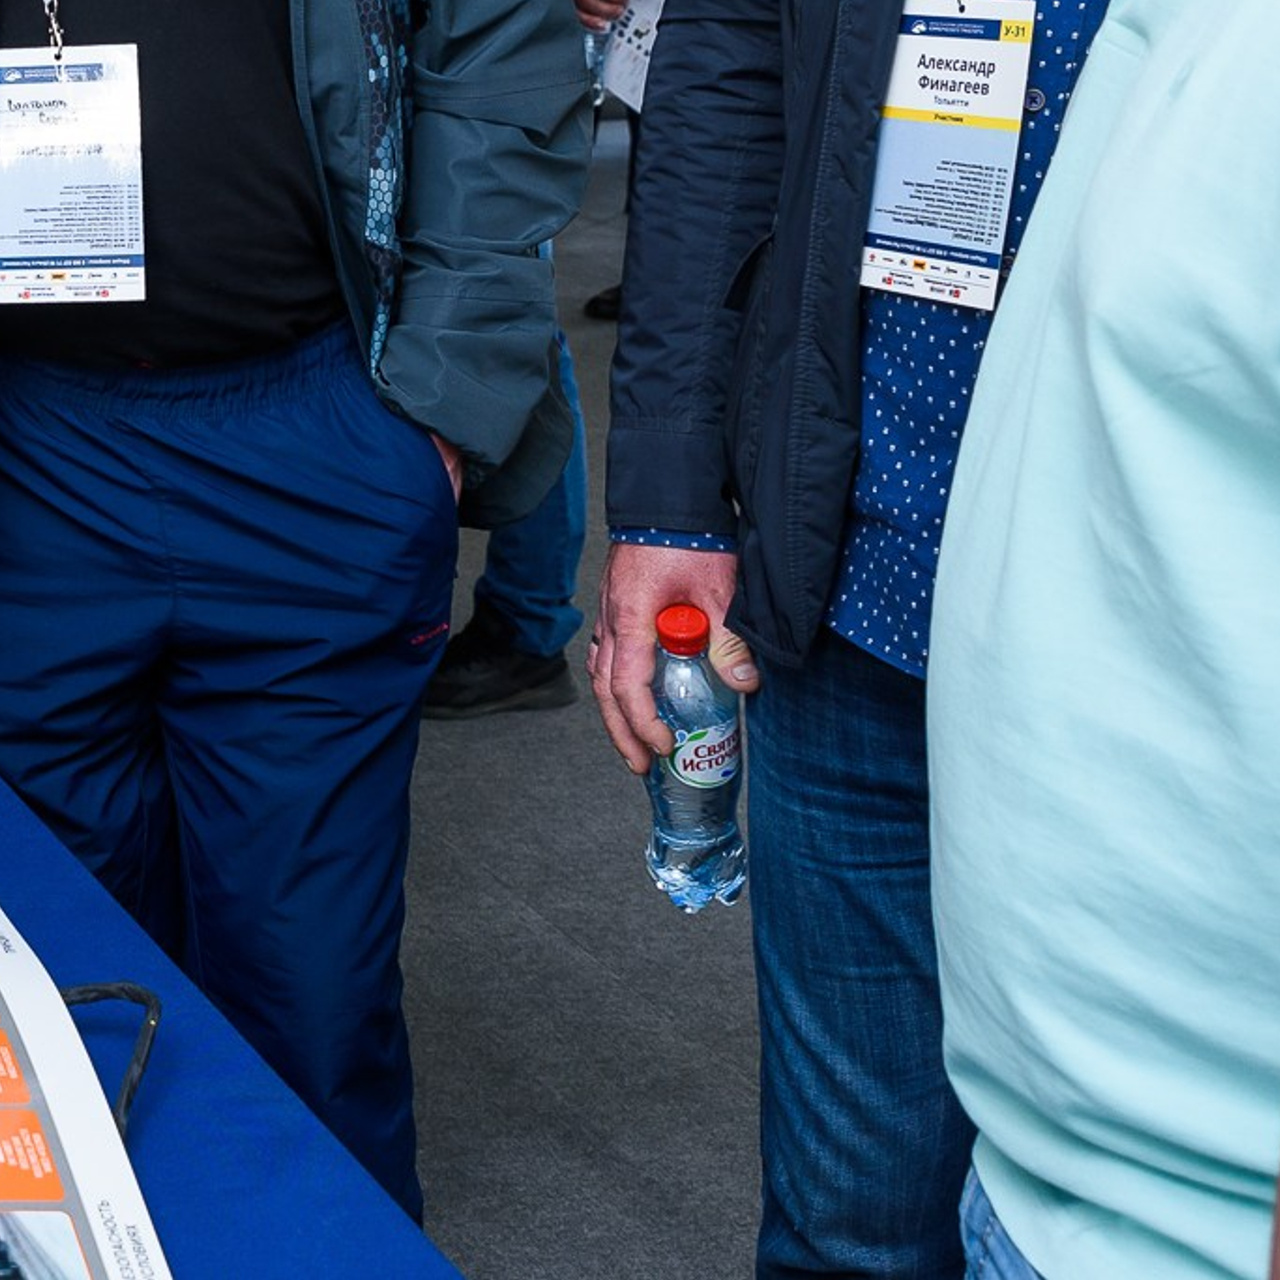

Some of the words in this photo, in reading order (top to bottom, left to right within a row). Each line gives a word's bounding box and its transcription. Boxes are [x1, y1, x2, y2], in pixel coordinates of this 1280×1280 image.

[1003, 25, 1026, 37] У-31
[917, 53, 996, 79] Александр
[917, 75, 991, 96] Финагеев
